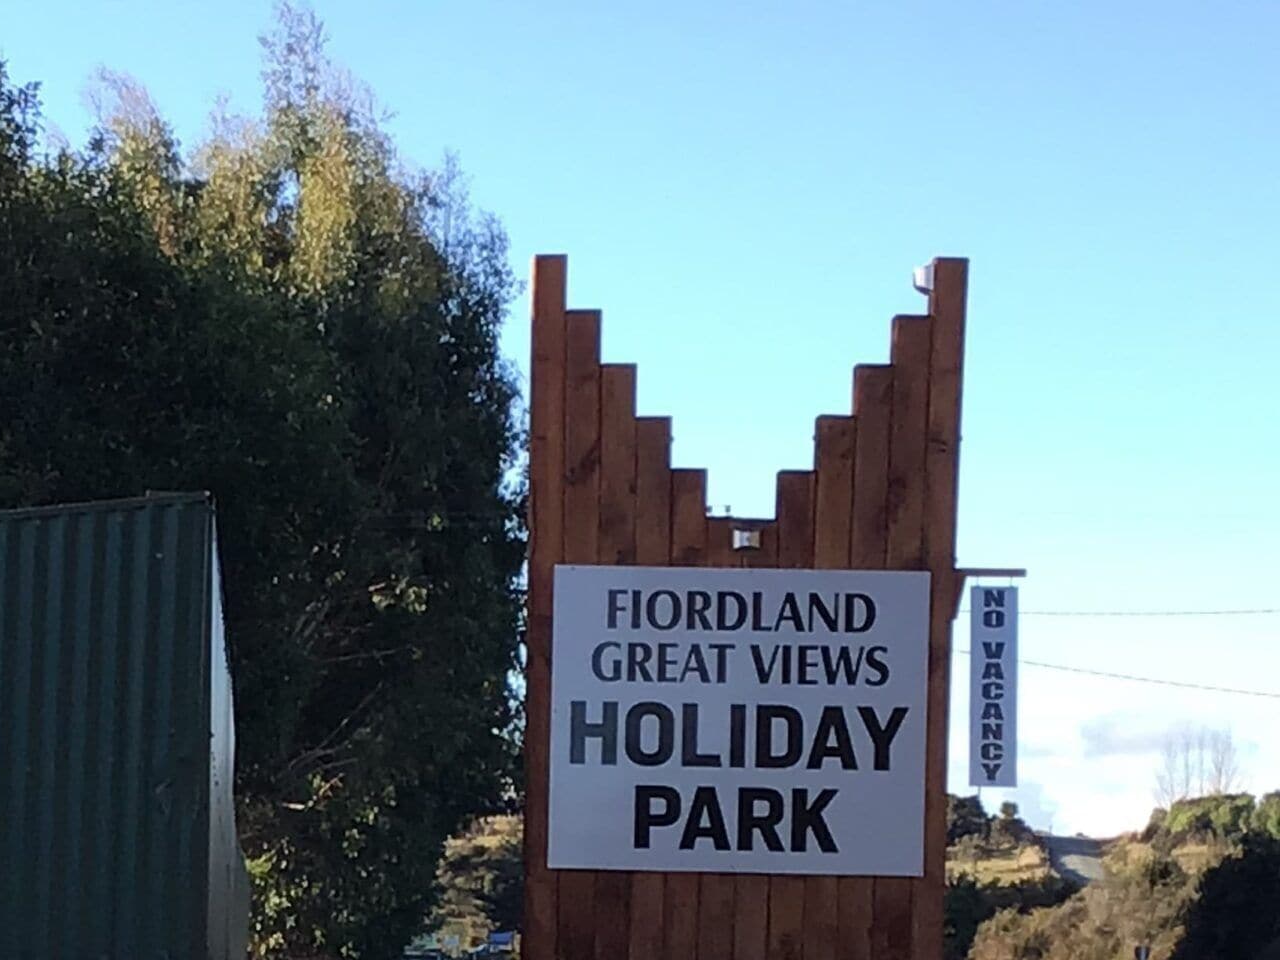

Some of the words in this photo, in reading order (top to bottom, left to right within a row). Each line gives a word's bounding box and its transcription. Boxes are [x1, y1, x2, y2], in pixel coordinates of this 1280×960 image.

[607, 588, 877, 633] FIORDLAND
[983, 589, 1006, 628] NO
[591, 641, 735, 683] GREAT
[751, 644, 890, 686] VIEWS
[569, 700, 910, 771] HOLIDAY
[981, 641, 1006, 781] VACANCY
[633, 785, 839, 853] PARK
